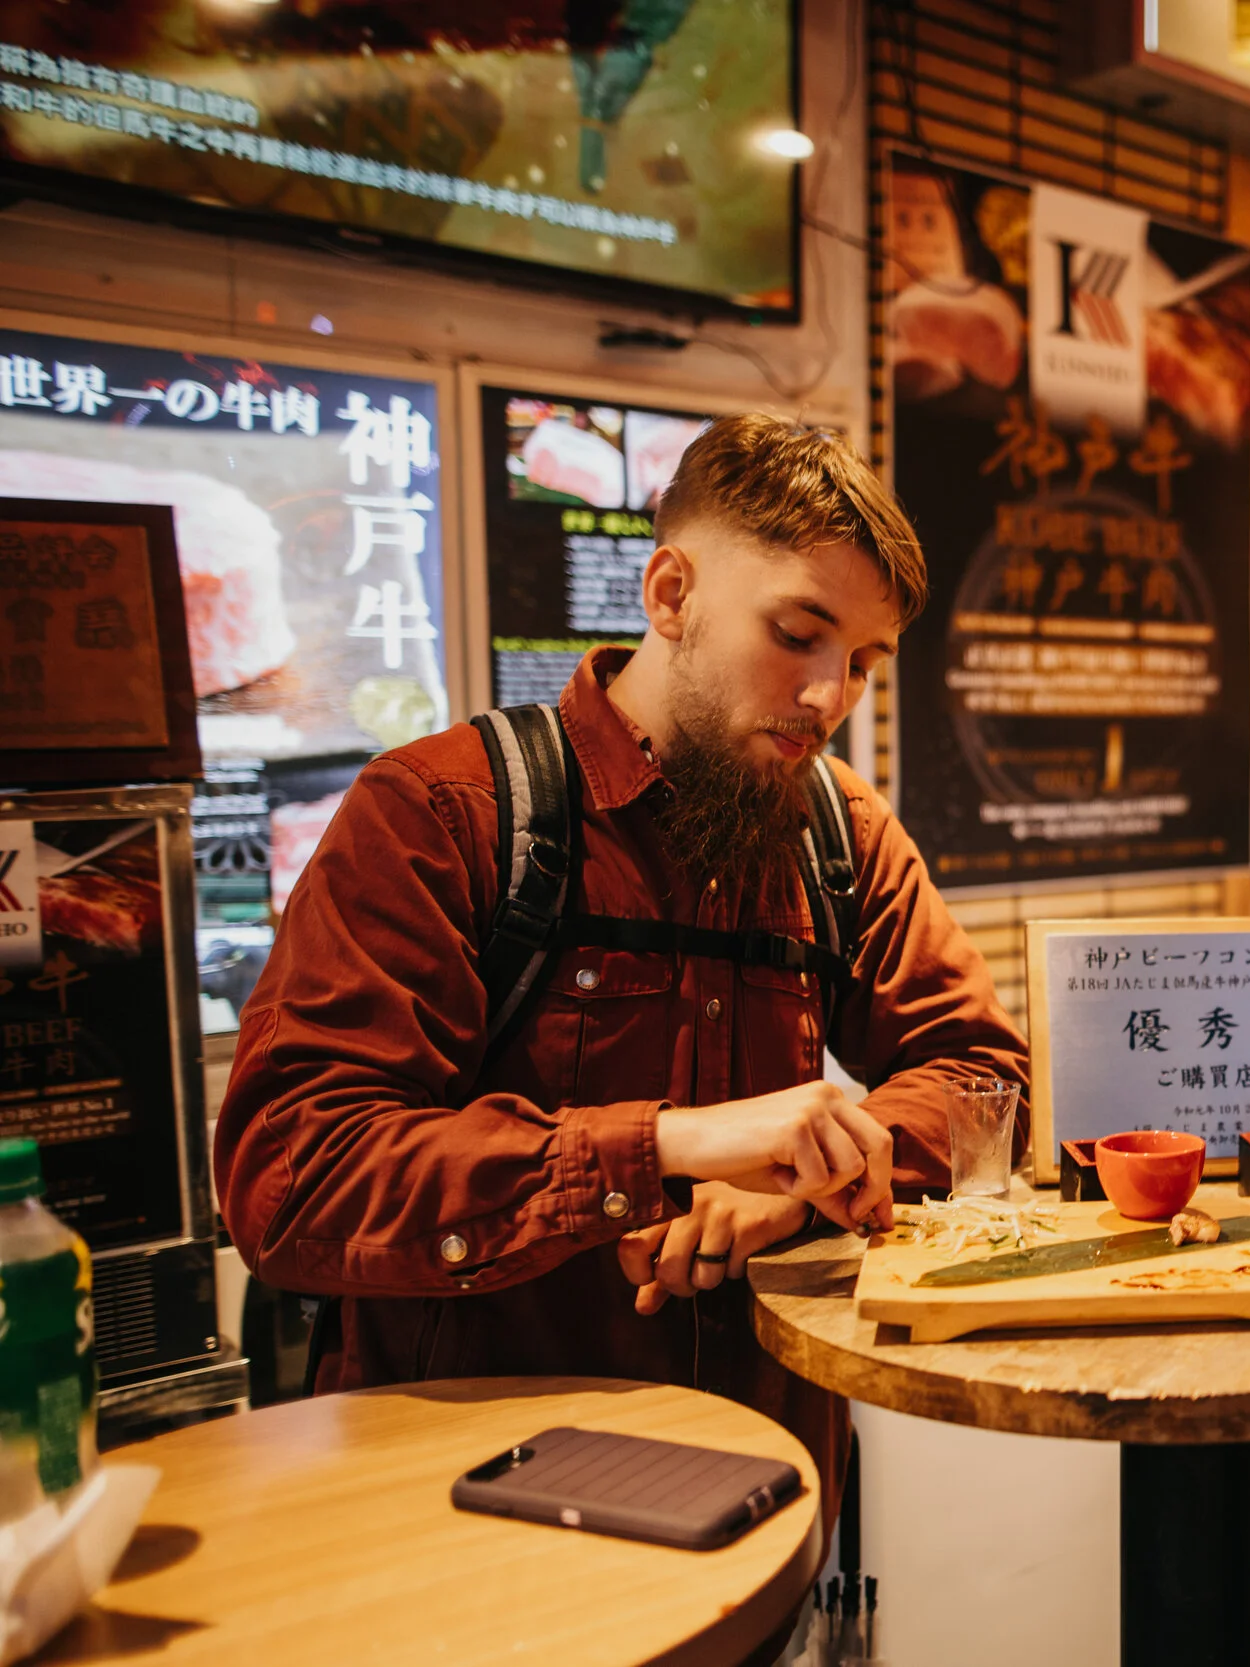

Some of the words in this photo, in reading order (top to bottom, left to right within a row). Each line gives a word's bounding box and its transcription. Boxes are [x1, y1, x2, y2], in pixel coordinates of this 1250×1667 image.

[0, 354, 320, 437] 世界一の牛肉
[337, 390, 439, 669] 神戸牛
[3, 1017, 82, 1048] BEEF
